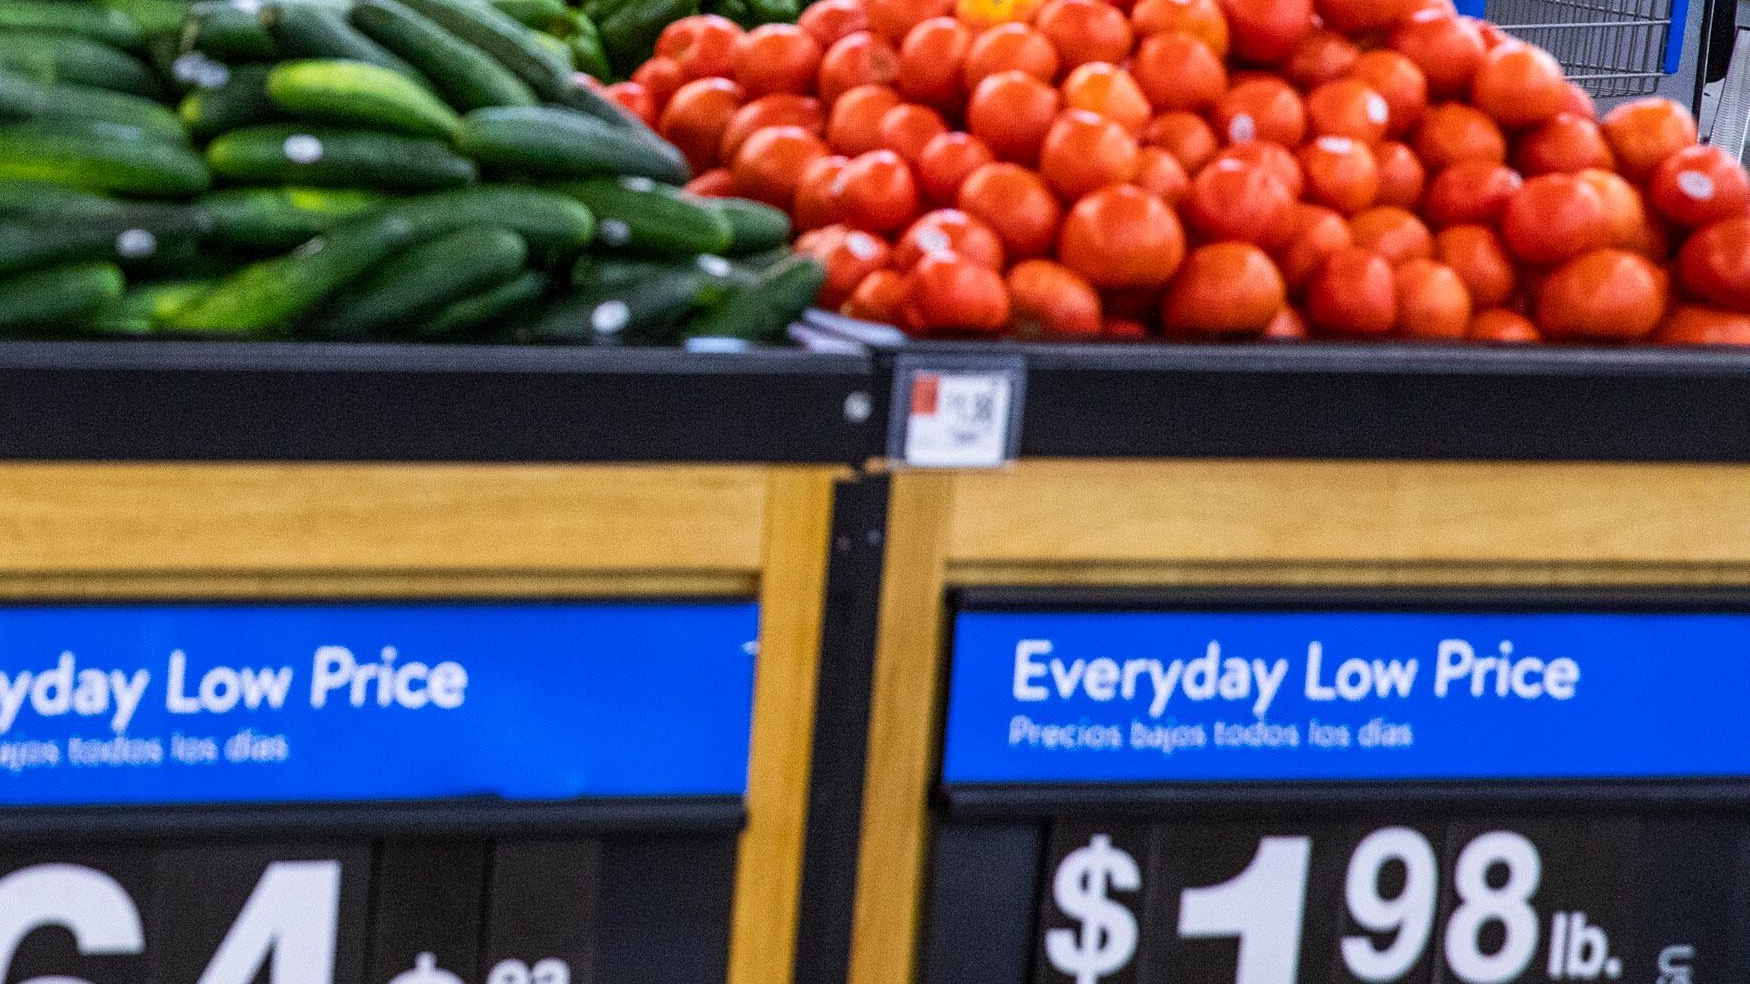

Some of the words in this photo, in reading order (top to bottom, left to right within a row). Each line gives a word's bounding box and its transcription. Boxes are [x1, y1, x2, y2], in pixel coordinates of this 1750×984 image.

[166, 650, 292, 713] Low
[310, 646, 467, 710] Price
[1013, 639, 1288, 718] Everyday
[1305, 640, 1418, 701] Low
[1435, 639, 1580, 700] Price
[68, 734, 163, 765] todos
[171, 733, 217, 763] los
[1009, 716, 1121, 747] Precios
[1130, 719, 1206, 754] bajos
[1214, 719, 1299, 747] todos
[1309, 719, 1350, 747] los
[1549, 912, 1622, 979] lb.
